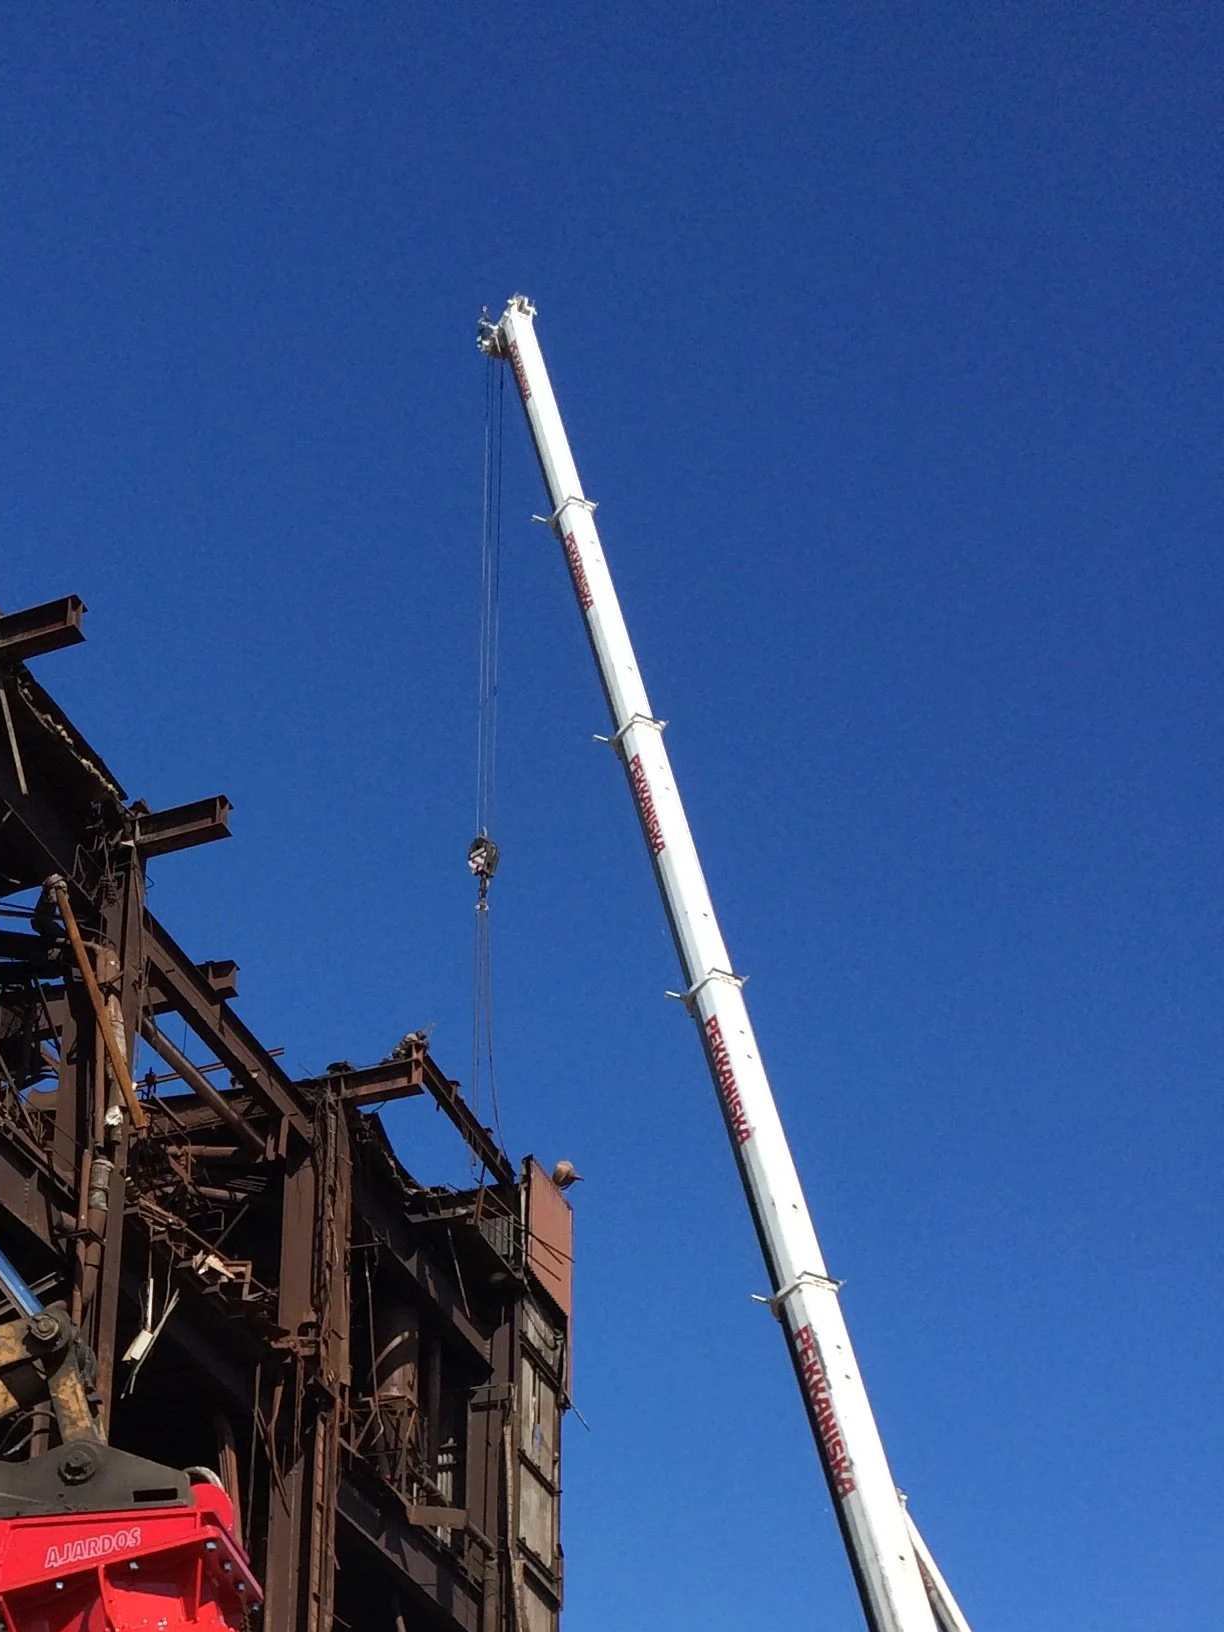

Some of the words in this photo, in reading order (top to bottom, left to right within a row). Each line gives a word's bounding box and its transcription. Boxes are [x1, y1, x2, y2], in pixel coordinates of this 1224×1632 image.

[704, 1014, 752, 1146] PEKKANISKA
[794, 1324, 856, 1500] PEKKANISKA
[44, 1526, 141, 1569] AJARDOS
